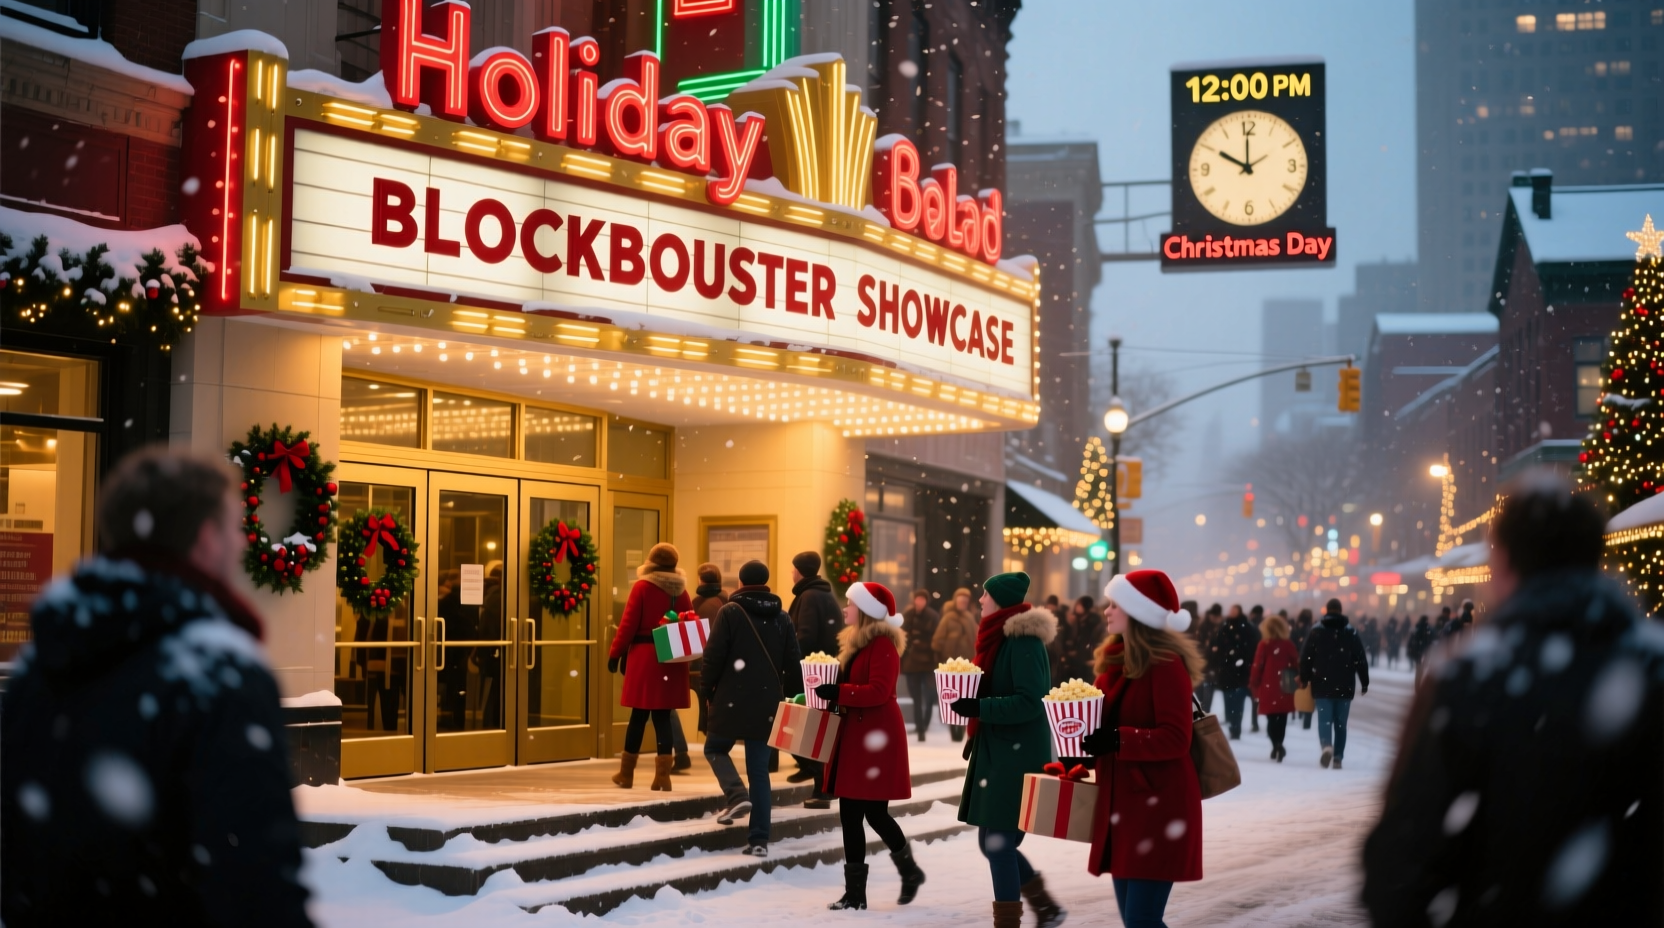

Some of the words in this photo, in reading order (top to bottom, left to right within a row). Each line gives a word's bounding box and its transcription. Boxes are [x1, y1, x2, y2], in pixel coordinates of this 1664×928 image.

[1186, 72, 1269, 103] 12:00
[1273, 73, 1311, 97] PM
[386, 0, 765, 205] Holiday
[1241, 120, 1256, 136] 12
[1200, 162, 1211, 177] 9
[1286, 158, 1298, 174] 3
[1244, 200, 1255, 217] 6
[1163, 234, 1281, 260] Christmas
[1286, 231, 1333, 261] Day
[371, 177, 836, 319] BLOCKBOUSTER
[857, 274, 1014, 365] SHOWCASE
